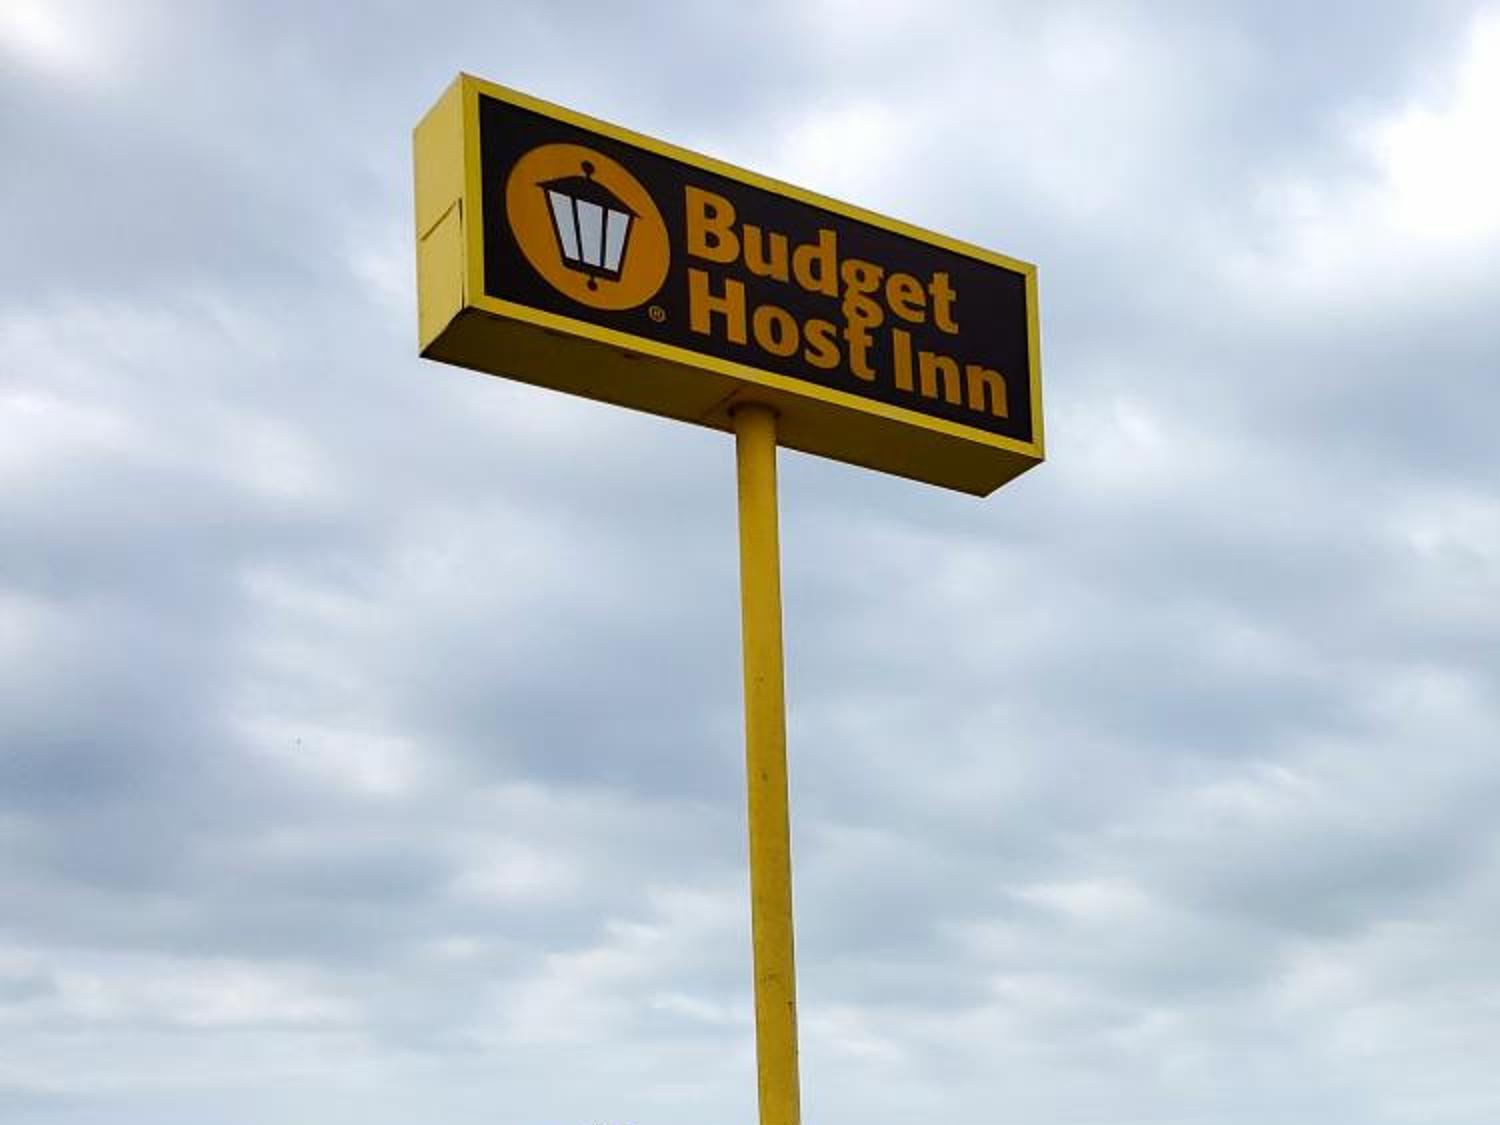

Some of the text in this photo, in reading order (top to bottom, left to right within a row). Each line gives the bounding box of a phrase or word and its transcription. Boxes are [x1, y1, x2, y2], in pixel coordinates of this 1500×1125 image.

[684, 185, 958, 334] Budget
[687, 269, 1008, 418] Host Inn
